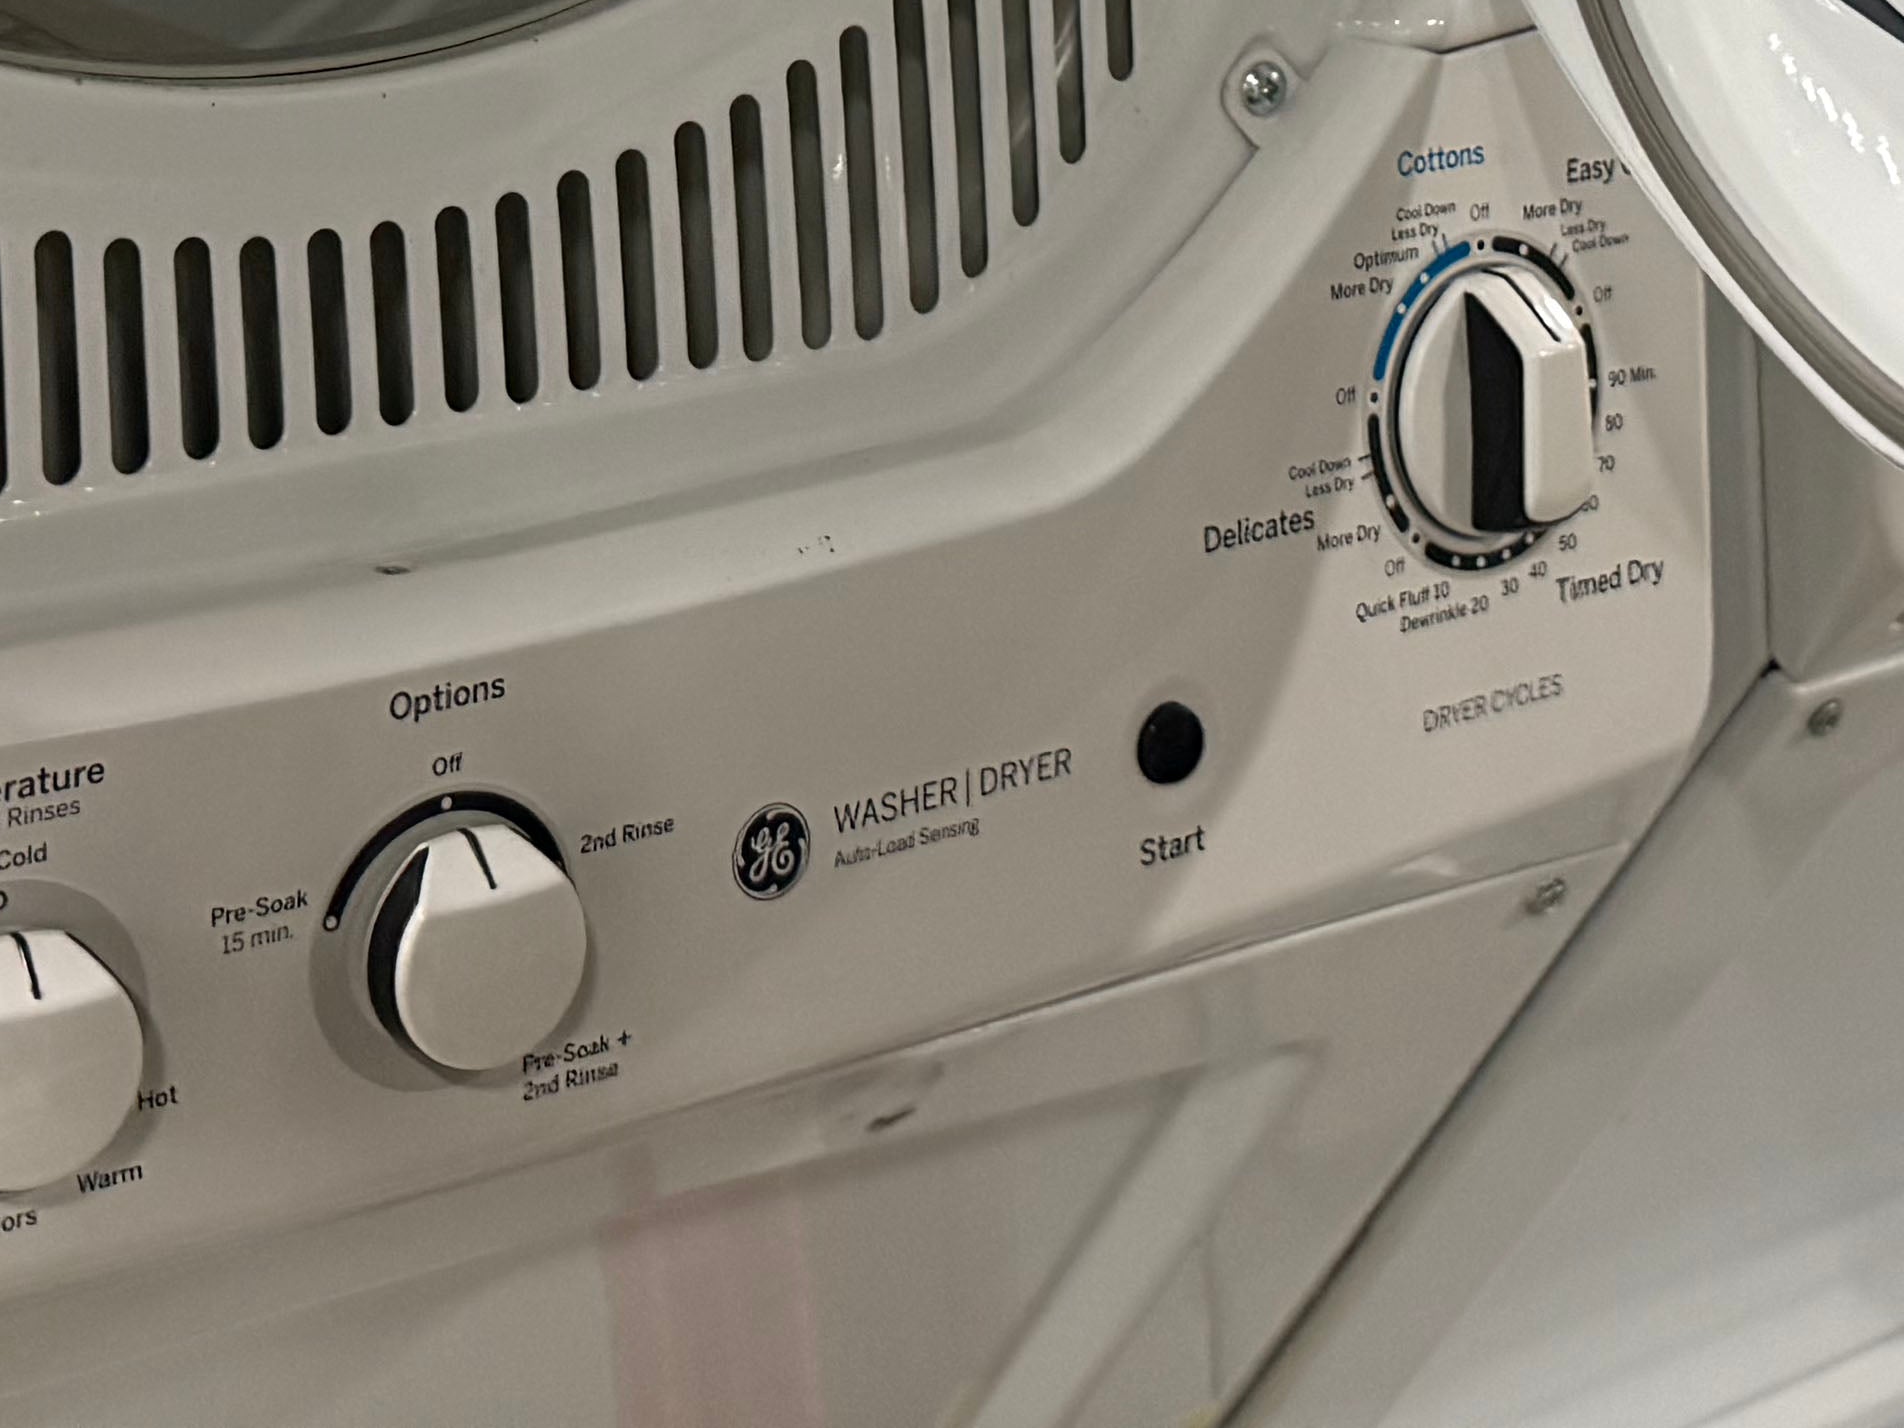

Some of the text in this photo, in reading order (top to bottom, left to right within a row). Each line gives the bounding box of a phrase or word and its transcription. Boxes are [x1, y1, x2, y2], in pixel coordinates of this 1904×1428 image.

[1396, 145, 1485, 179] Cottons
[1566, 157, 1615, 185] Easy
[1394, 202, 1457, 223] Cool Down
[1469, 202, 1490, 222] Off
[1522, 197, 1583, 222] More Dry
[1390, 222, 1439, 243] Less Dry
[1352, 247, 1419, 273] Optimum
[1330, 276, 1394, 301] More Dry
[1593, 286, 1613, 303] Off
[1608, 366, 1657, 388] 90 Min.
[1335, 386, 1356, 406] Off
[1605, 412, 1624, 432] 80
[1288, 457, 1352, 481] Cool Down
[1597, 454, 1616, 473] 70
[1305, 476, 1355, 499] Less Dry
[1203, 510, 1315, 554] Delicates
[1317, 524, 1381, 553] More Dry
[1558, 532, 1578, 552] 50
[1384, 557, 1406, 578] Off
[1528, 560, 1548, 579] 40
[1555, 559, 1664, 604] Timed Dry
[1501, 577, 1520, 597] 30
[1355, 581, 1450, 624] Quick Fluff 10
[1399, 594, 1490, 634] Dewrinkle 20
[389, 677, 506, 724] Options
[1422, 673, 1564, 734] DRYER CYCLES
[431, 751, 463, 777] Off
[833, 747, 1072, 833] WASHER DRYER
[7, 799, 81, 828] Rinses
[580, 818, 674, 855] 2nd Rinse
[833, 817, 980, 869] Auto-Load Sensing
[1139, 824, 1206, 867] Start
[211, 889, 309, 928] Pre-Soak
[222, 925, 294, 955] 15 min.
[521, 1029, 632, 1076] Pre-Soak +
[522, 1062, 619, 1102] 2nd Rinse
[136, 1085, 178, 1113] Hot
[76, 1165, 143, 1194] Warm
